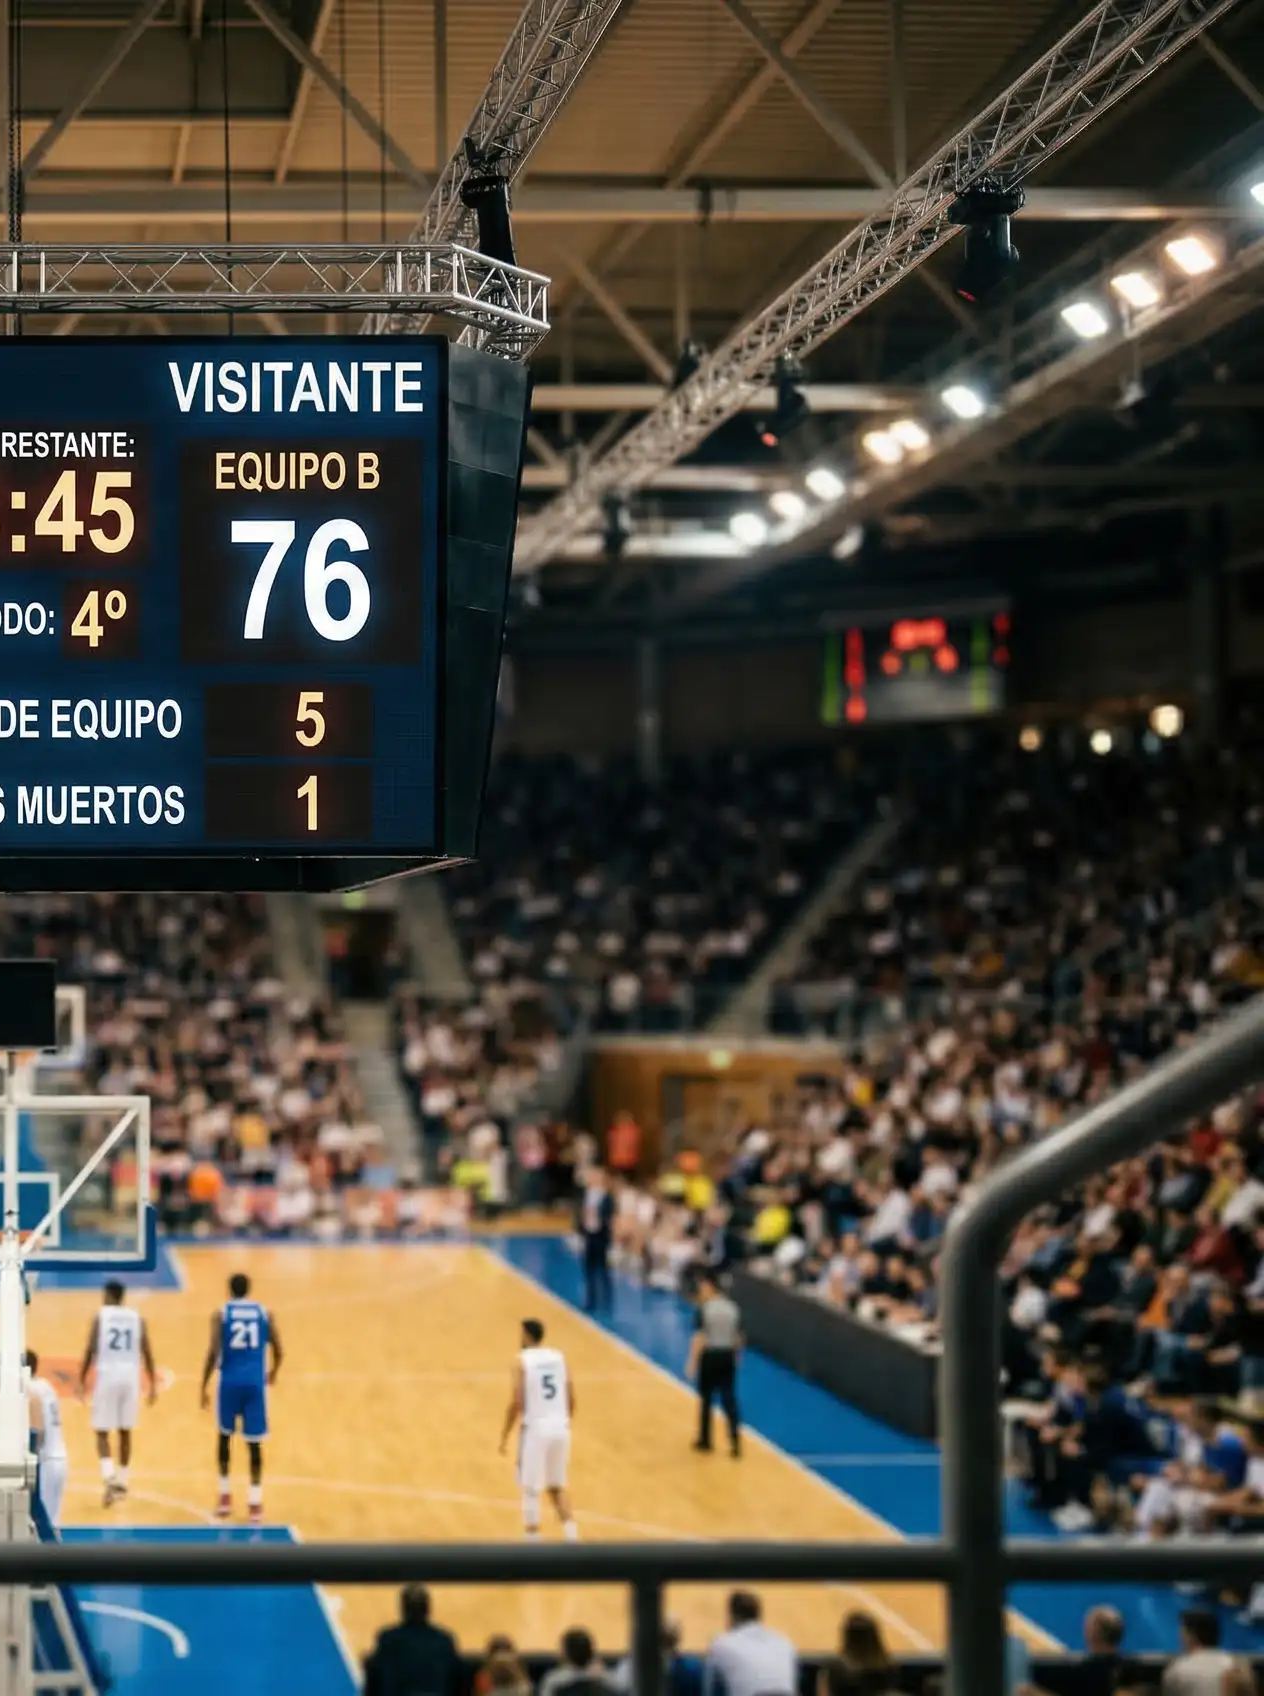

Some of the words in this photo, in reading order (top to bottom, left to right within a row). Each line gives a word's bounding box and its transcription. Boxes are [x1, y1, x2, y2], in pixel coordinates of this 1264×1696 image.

[168, 361, 424, 413] VISITANTE
[1, 431, 137, 458] RESTANTE:
[215, 452, 347, 493] EQUIPO
[358, 452, 381, 490] B
[230, 518, 372, 642] 76
[51, 698, 183, 741] EQUIPO
[295, 691, 326, 747] 5
[17, 785, 186, 825] MUERTOS
[297, 775, 318, 831] 1
[109, 1328, 133, 1351] 21
[230, 1322, 260, 1349] 21
[542, 1375, 556, 1399] 5
